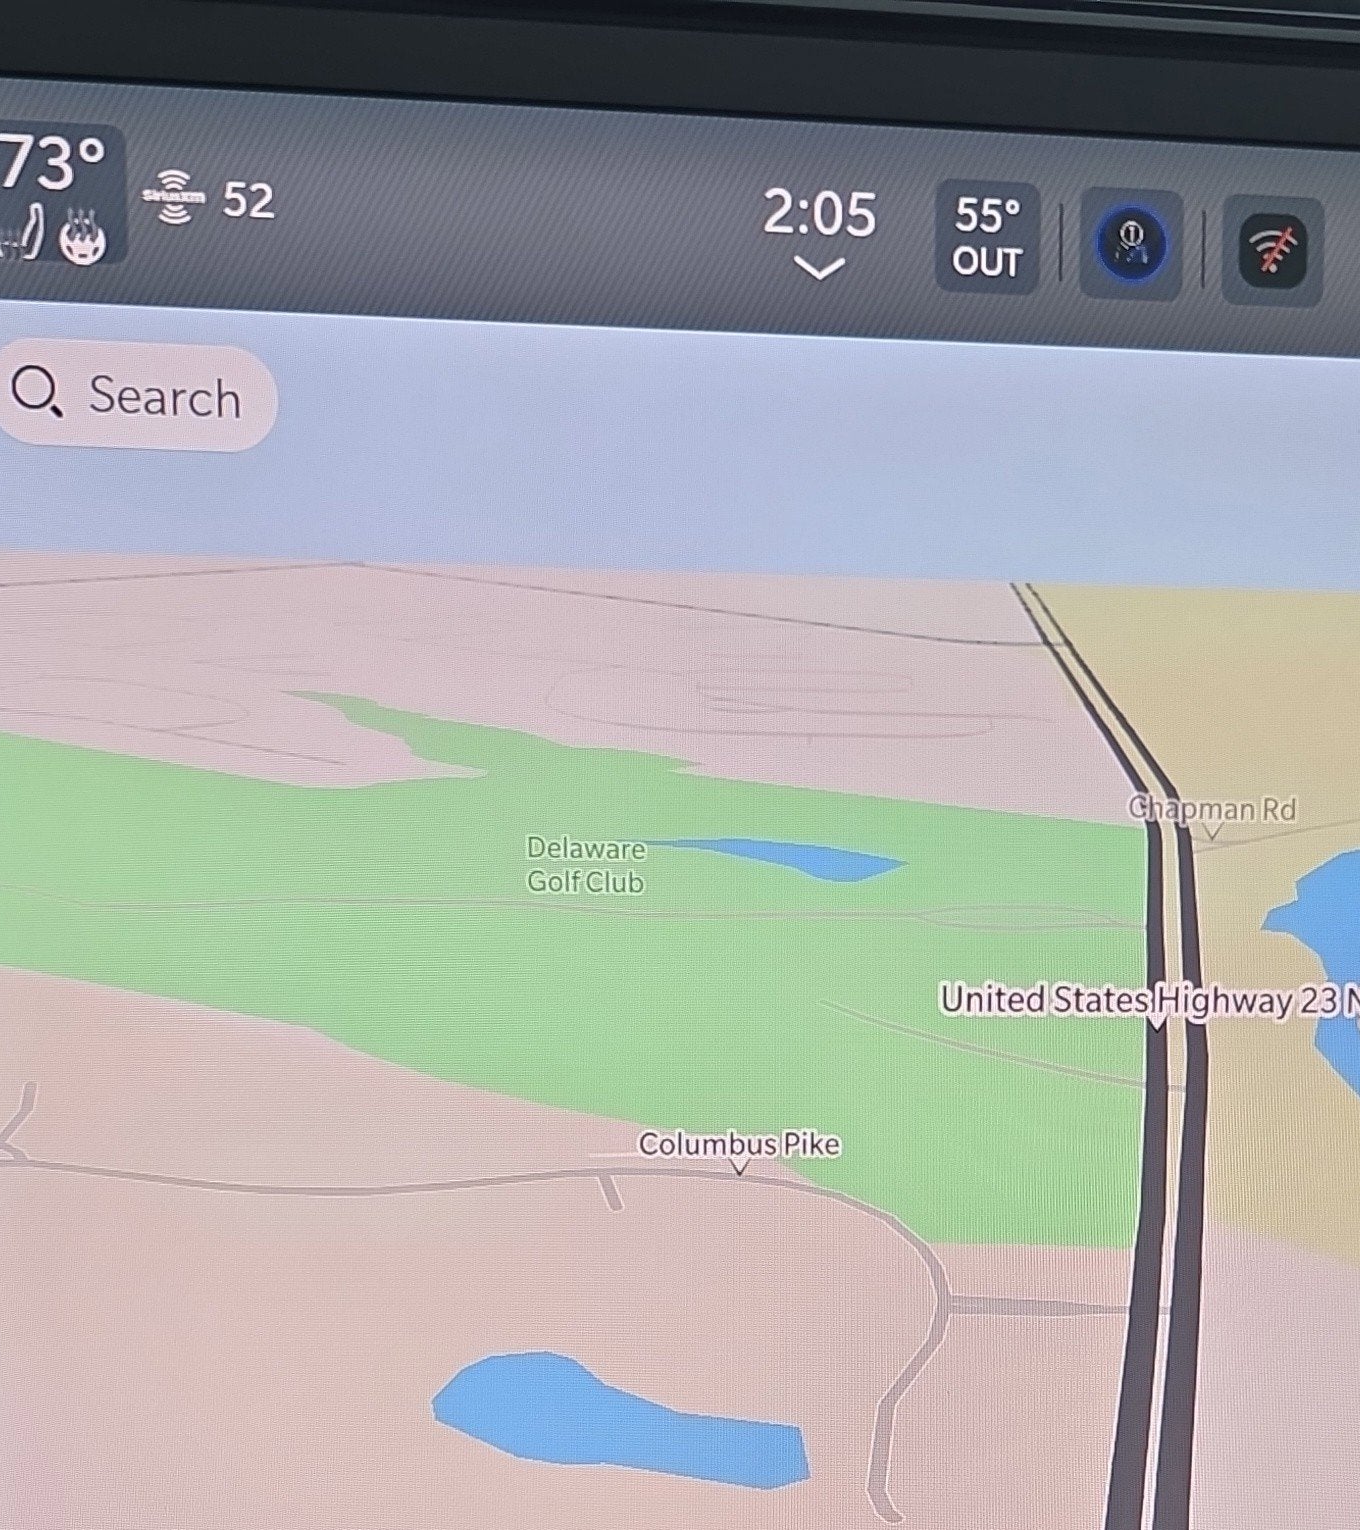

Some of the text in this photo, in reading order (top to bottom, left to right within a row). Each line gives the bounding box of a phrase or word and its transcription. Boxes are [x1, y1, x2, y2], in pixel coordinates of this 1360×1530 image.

[223, 181, 275, 219] 52
[764, 187, 876, 237] 2:05
[955, 196, 1020, 233] 55°
[953, 245, 1024, 277] OUT
[89, 374, 240, 419] Search
[1128, 792, 1296, 826] Chapman Rd
[526, 835, 647, 859] Delaware
[527, 870, 644, 893] Golf Club
[941, 985, 1045, 1013] United
[1054, 985, 1149, 1013] States
[1158, 986, 1293, 1020] Highway
[1301, 988, 1340, 1013] 23
[639, 1131, 840, 1156] Columbus Pike
